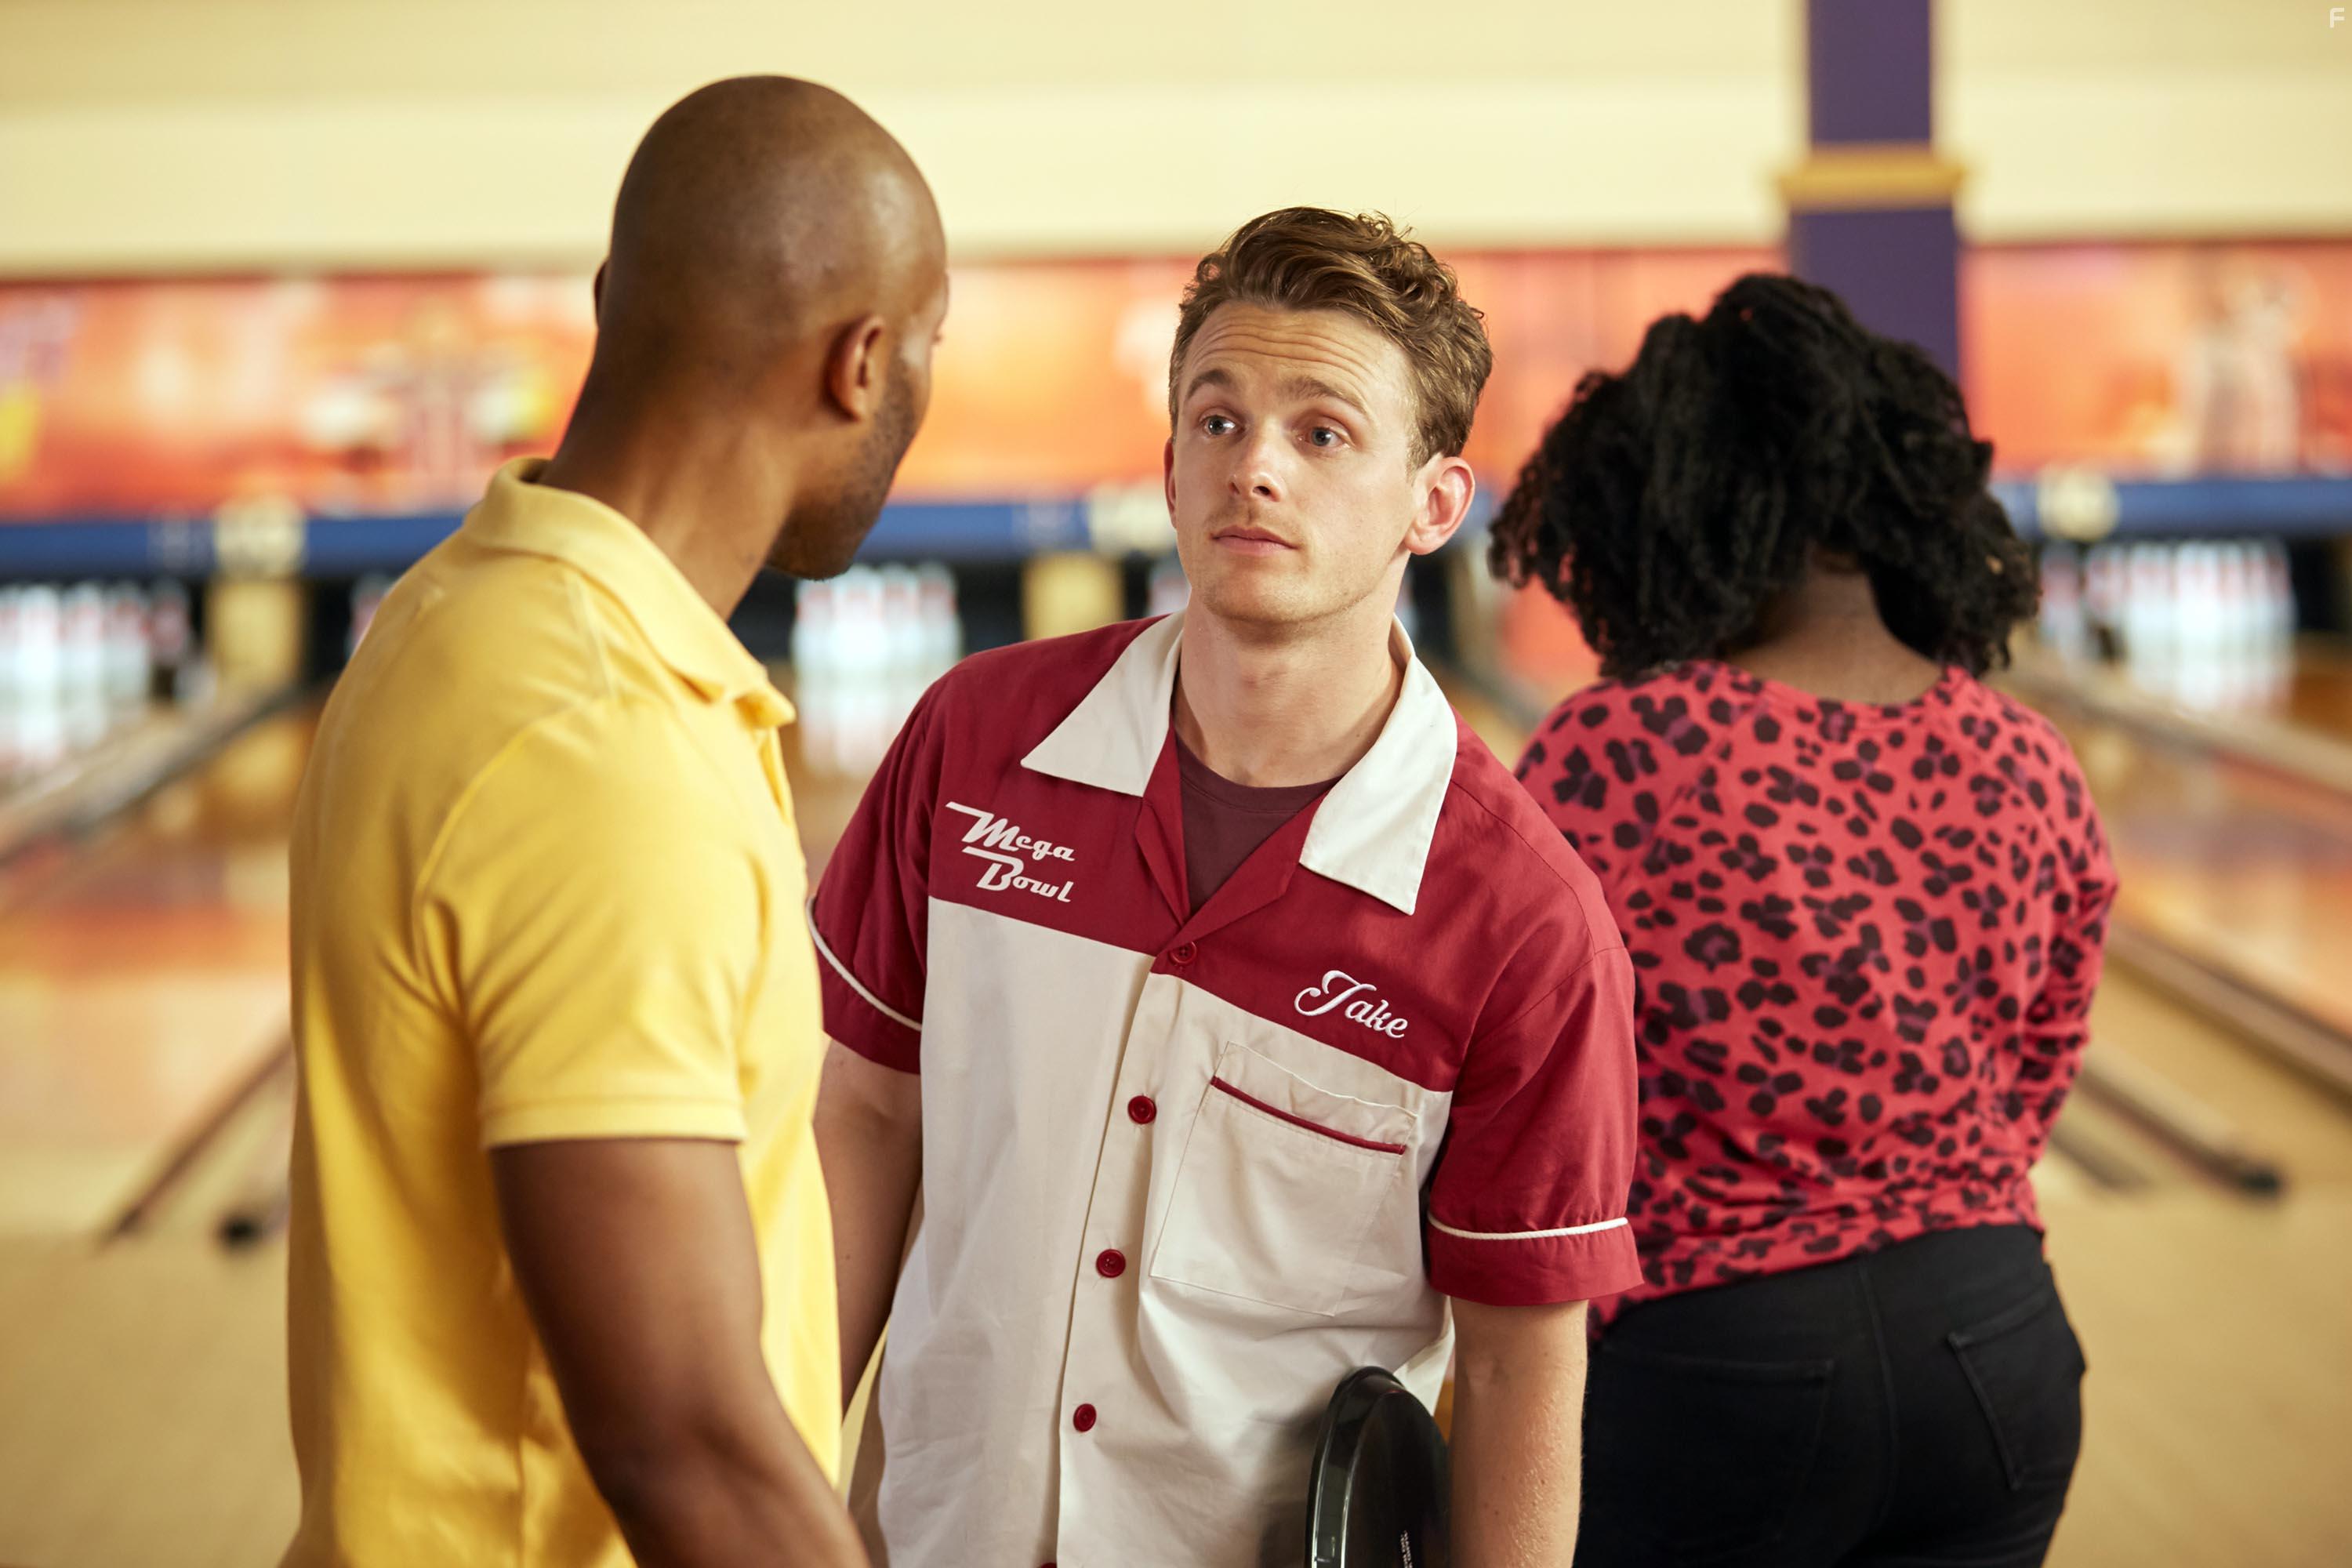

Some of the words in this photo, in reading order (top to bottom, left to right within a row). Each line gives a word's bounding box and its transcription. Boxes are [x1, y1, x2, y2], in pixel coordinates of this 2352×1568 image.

[946, 801, 1075, 861] Mega
[961, 846, 1074, 902] Bowl
[1294, 970, 1408, 1038] Jake
